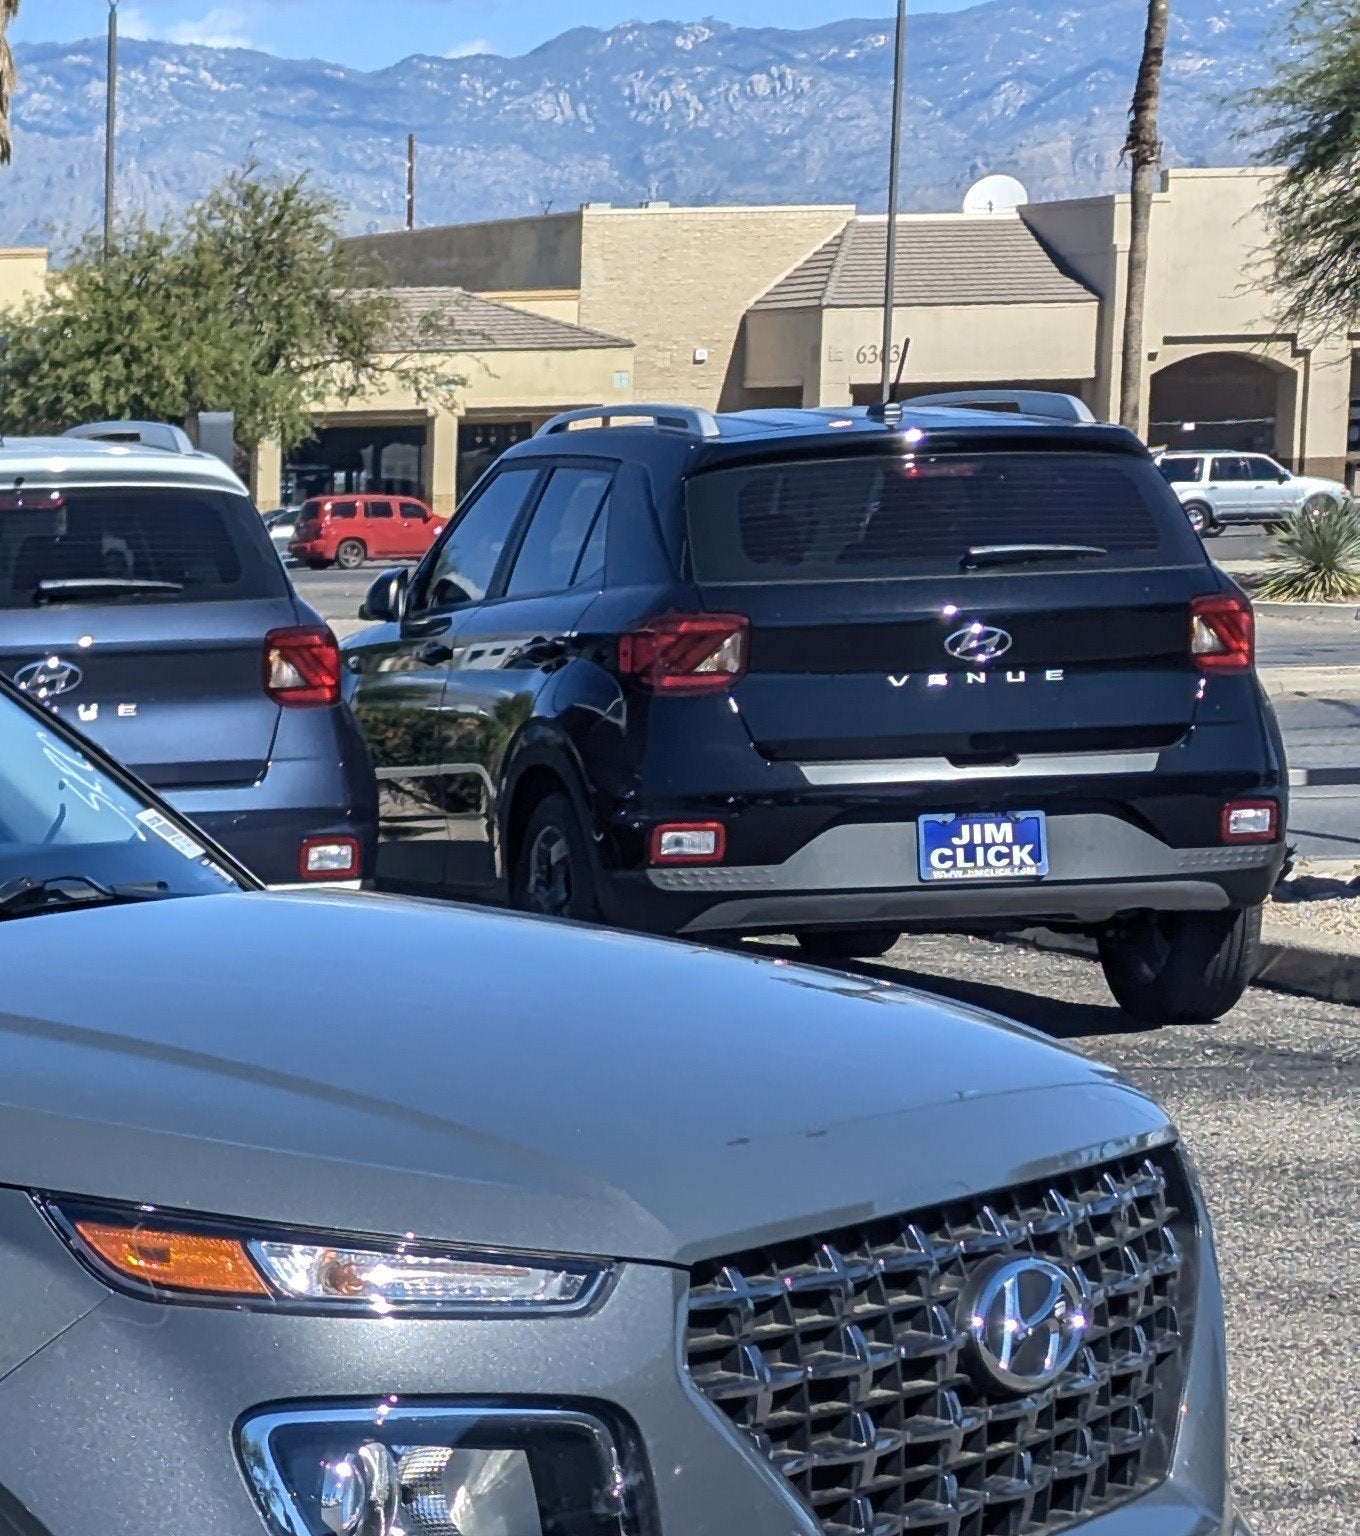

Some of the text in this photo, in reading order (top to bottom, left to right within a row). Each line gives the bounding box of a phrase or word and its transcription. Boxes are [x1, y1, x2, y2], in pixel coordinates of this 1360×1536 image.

[855, 344, 900, 364] 633
[887, 669, 1064, 687] VENUE
[951, 823, 1014, 845] JIM
[930, 844, 1035, 869] CLICK
